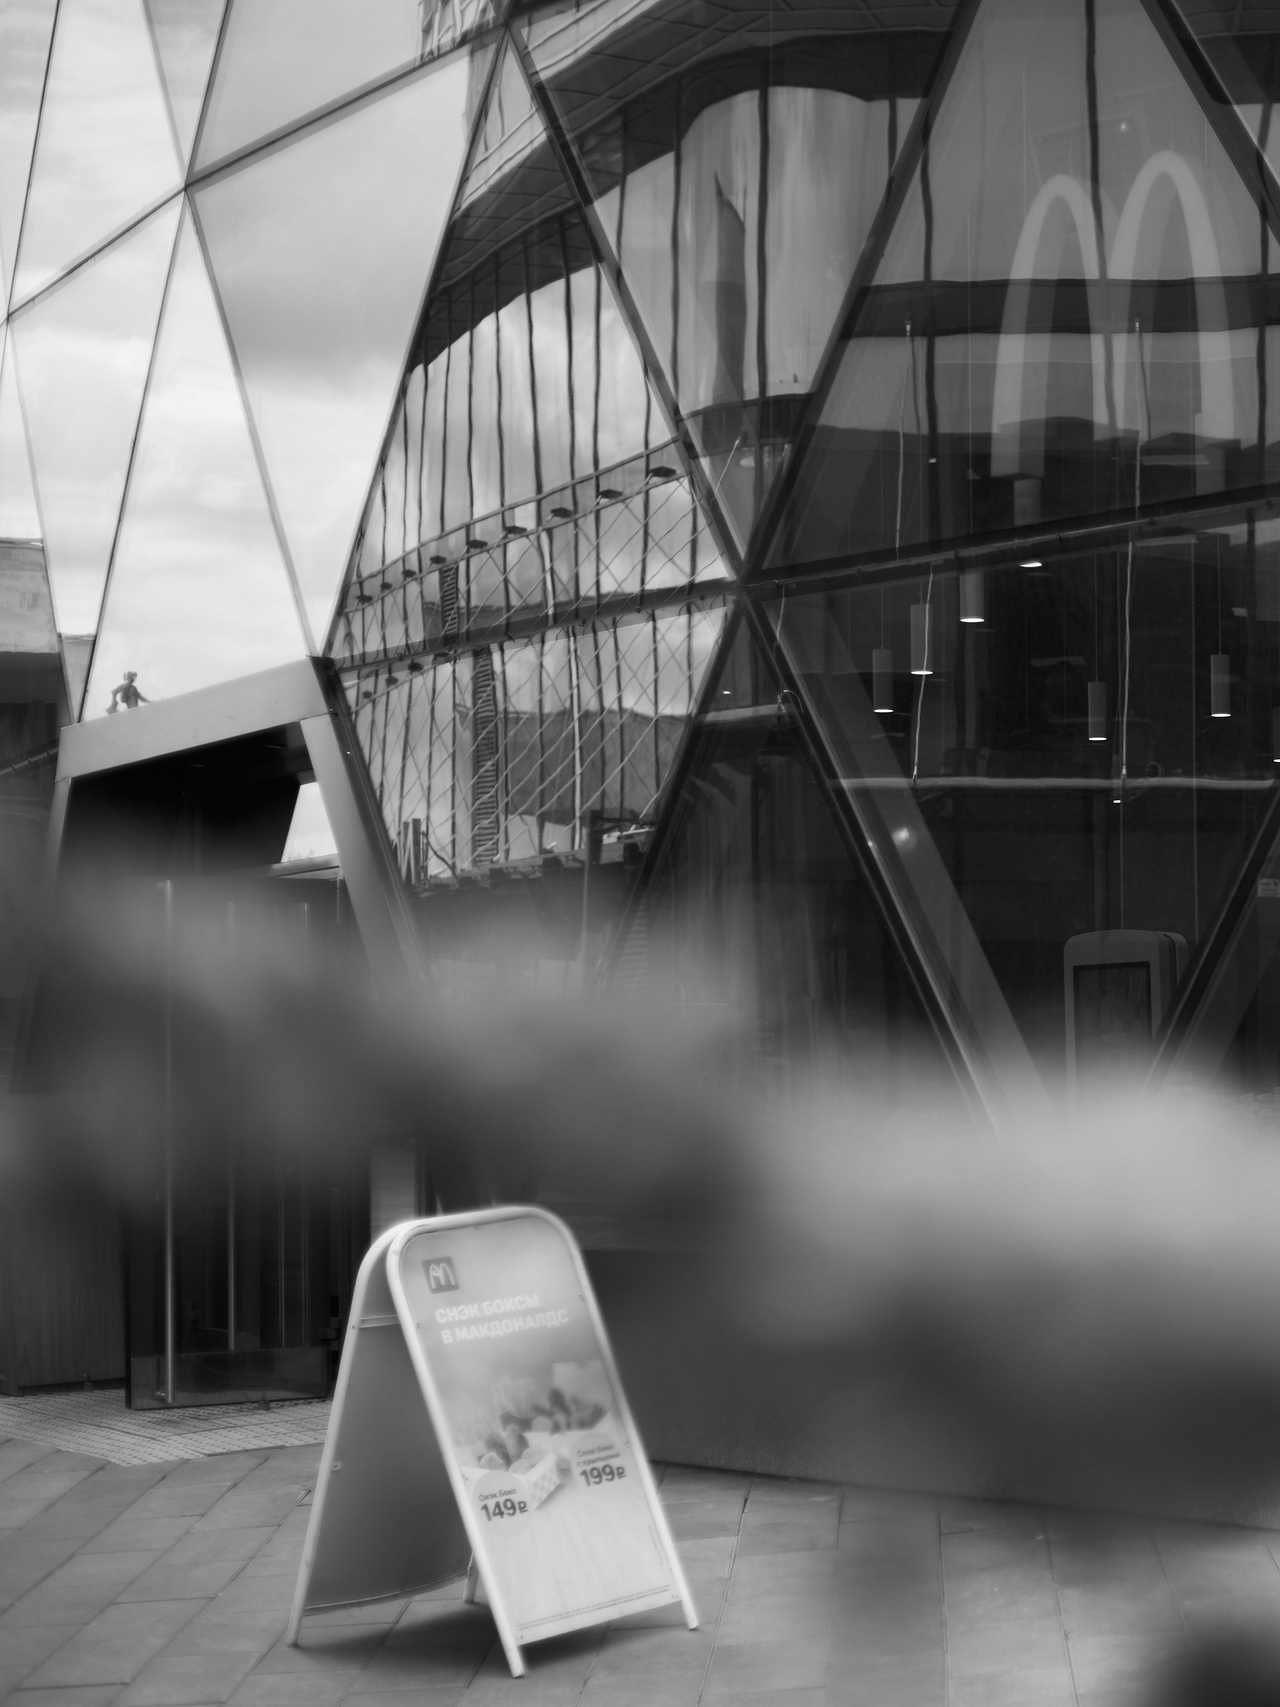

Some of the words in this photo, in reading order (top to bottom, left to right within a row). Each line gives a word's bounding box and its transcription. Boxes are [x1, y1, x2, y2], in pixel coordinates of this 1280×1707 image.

[434, 1302, 480, 1323] СНЭК
[482, 1293, 541, 1316] БОКСЫ
[440, 1328, 453, 1345] В
[455, 1309, 570, 1342] МАКДОНАЛДС
[478, 1491, 498, 1502] Снэк
[499, 1487, 518, 1498] Бокс
